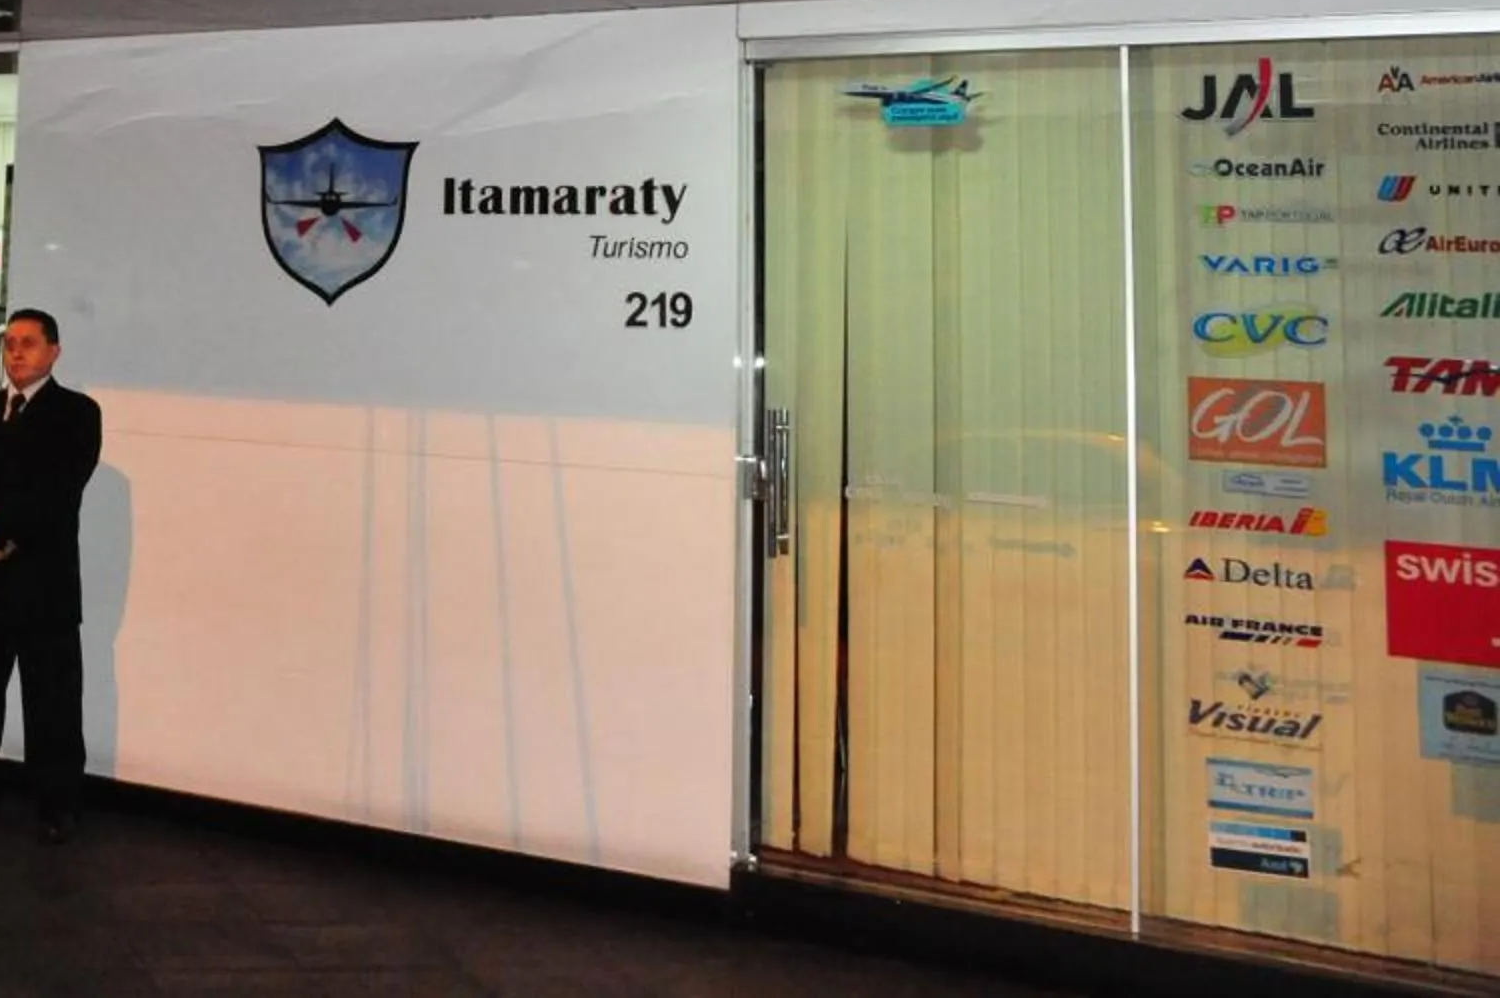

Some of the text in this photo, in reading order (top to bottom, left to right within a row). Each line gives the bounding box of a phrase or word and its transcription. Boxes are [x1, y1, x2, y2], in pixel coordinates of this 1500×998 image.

[1181, 60, 1315, 132] JAL
[1377, 122, 1488, 137] Continental
[1415, 137, 1490, 151] Airlines
[1214, 158, 1325, 179] OceanAir
[444, 177, 687, 224] Itamaraty
[1430, 184, 1500, 196] UNIT
[589, 235, 689, 259] Turismo
[1202, 255, 1318, 274] VARIG
[625, 291, 693, 328] 219
[1194, 313, 1328, 345] CVC
[1192, 388, 1324, 447] GOL
[1189, 511, 1285, 533] IBERIA
[1221, 557, 1314, 590] Delta
[1185, 614, 1323, 637] AIR FRANCE
[1187, 698, 1322, 740] Visual
